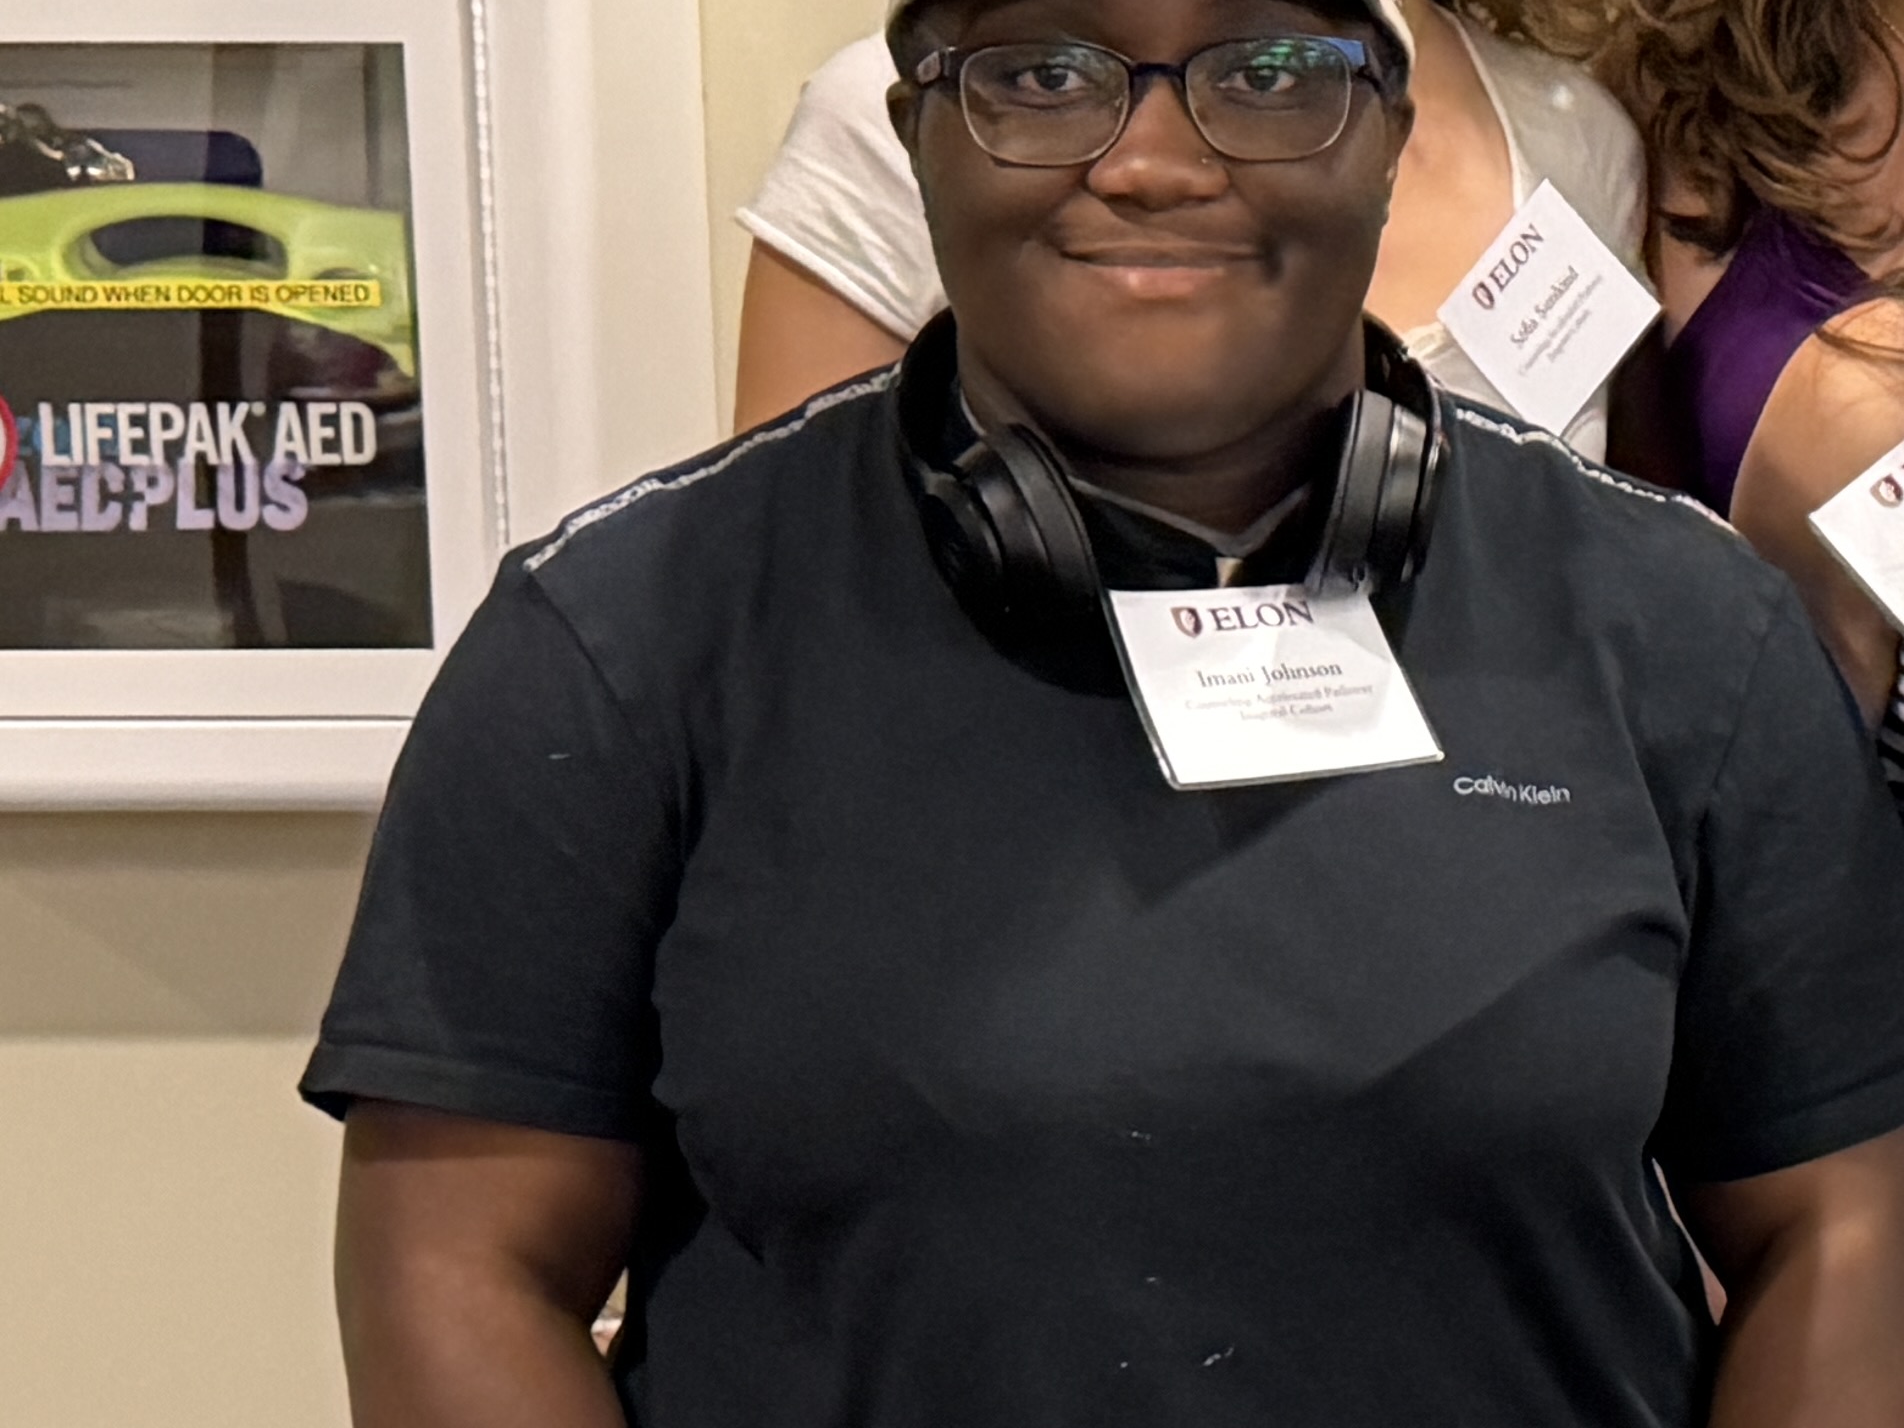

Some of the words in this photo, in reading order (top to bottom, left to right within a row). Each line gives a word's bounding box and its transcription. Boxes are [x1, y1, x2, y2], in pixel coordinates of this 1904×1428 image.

[1488, 222, 1546, 294] ELON
[18, 285, 98, 305] SOUND
[102, 285, 173, 304] WHEN
[177, 285, 243, 304] DOOR
[249, 285, 271, 303] IS
[275, 285, 370, 304] OPENED
[39, 401, 250, 466] LIFEPAK
[274, 401, 377, 465] AED
[1212, 599, 1316, 633] ELON
[1195, 668, 1257, 689] Imani
[1261, 659, 1344, 687] Johnson
[1453, 775, 1519, 804] Calvin
[1519, 782, 1571, 807] Klein
